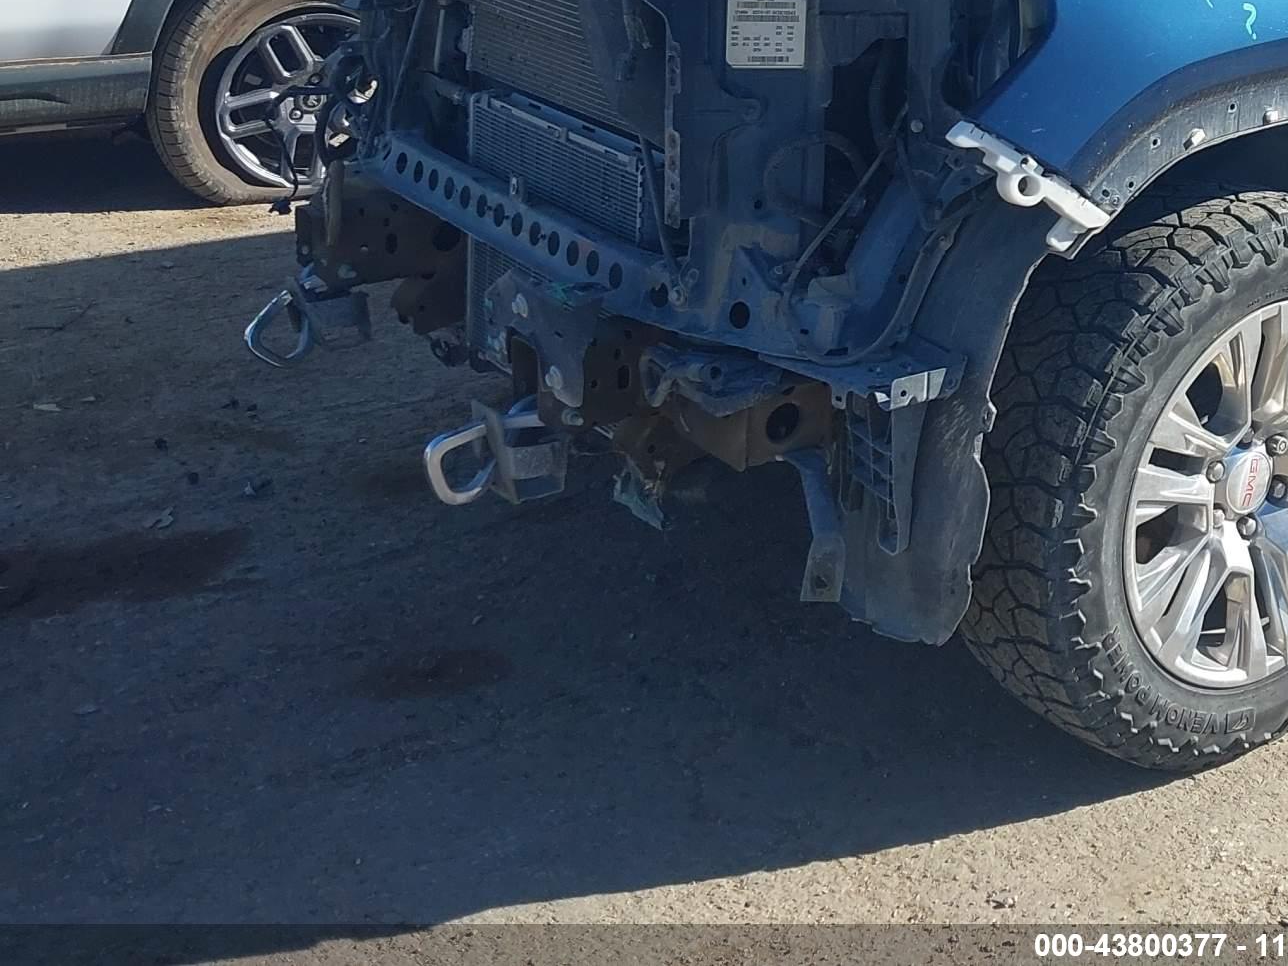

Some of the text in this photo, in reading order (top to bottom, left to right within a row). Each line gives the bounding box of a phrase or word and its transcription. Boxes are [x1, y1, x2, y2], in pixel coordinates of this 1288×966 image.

[1242, 456, 1261, 507] GMC
[1102, 626, 1151, 706] POWER
[1149, 693, 1220, 735] VENOM
